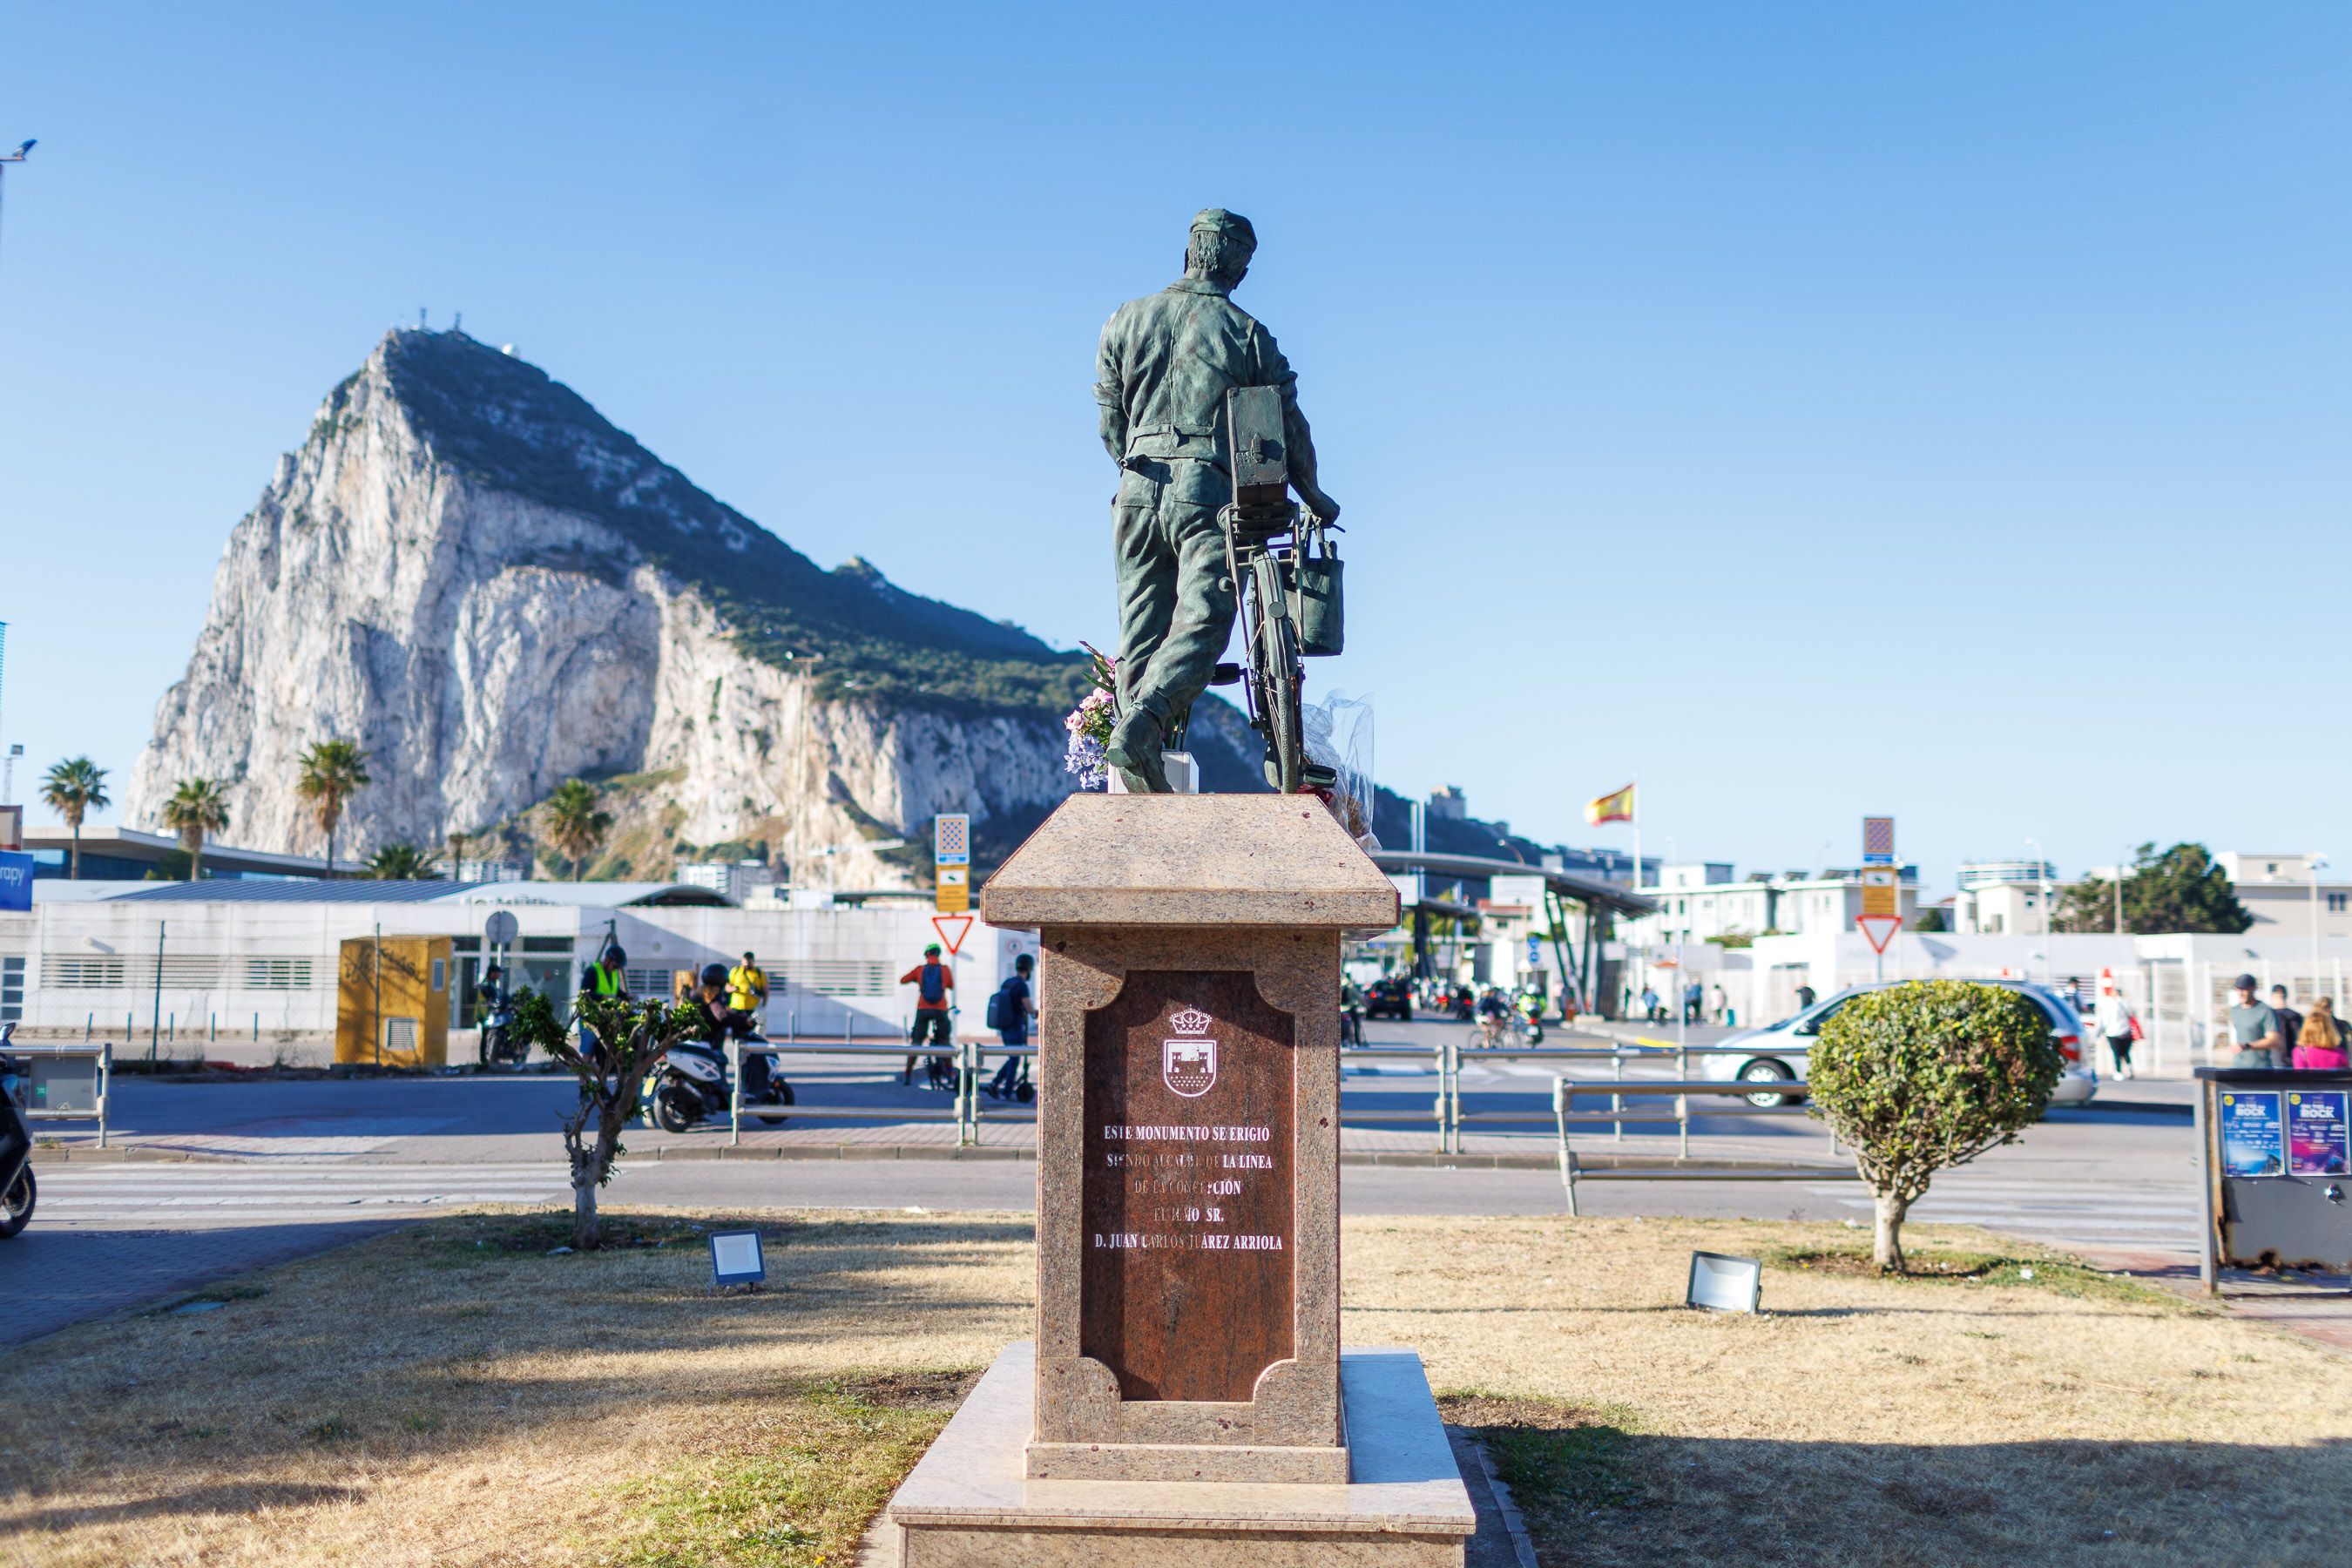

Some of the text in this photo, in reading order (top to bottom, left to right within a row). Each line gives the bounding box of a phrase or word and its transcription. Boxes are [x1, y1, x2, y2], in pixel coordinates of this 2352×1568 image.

[2301, 1109, 2335, 1118] ROCK
[1105, 1123, 1269, 1141] ESTE MONUMENTO SE ERIGIÓ
[1223, 1155, 1235, 1168] LA
[1206, 1207, 1224, 1221] SR.
[1095, 1233, 1106, 1247] D.
[1109, 1233, 1138, 1248] JUAN
[1233, 1235, 1282, 1250] ARRIOLA
